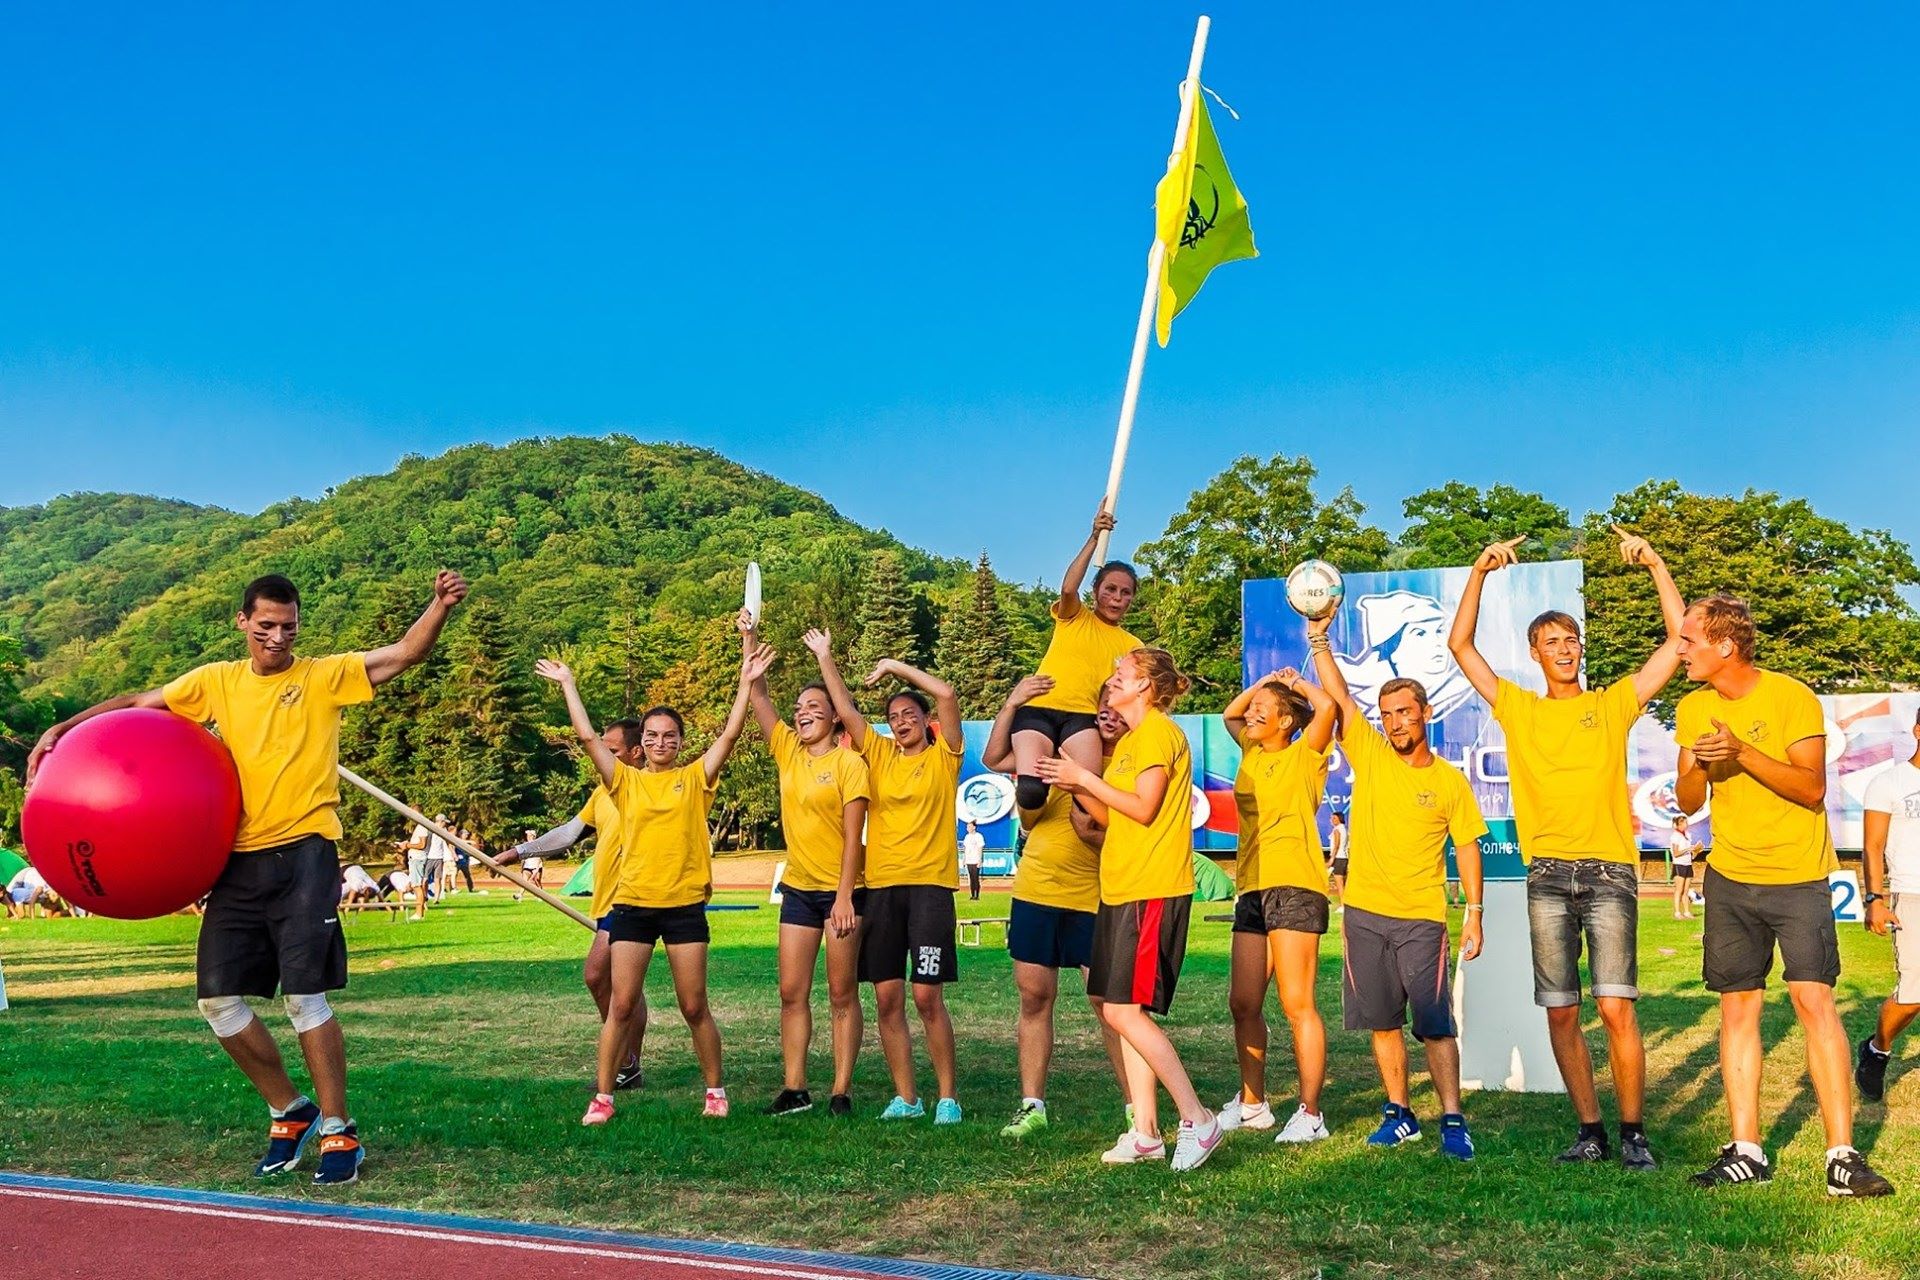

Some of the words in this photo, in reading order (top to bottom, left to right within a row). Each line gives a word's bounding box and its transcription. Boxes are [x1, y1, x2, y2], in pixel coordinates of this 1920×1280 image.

[1829, 880, 1857, 920] 2
[919, 945, 942, 957] MIAMI
[917, 953, 941, 976] 36
